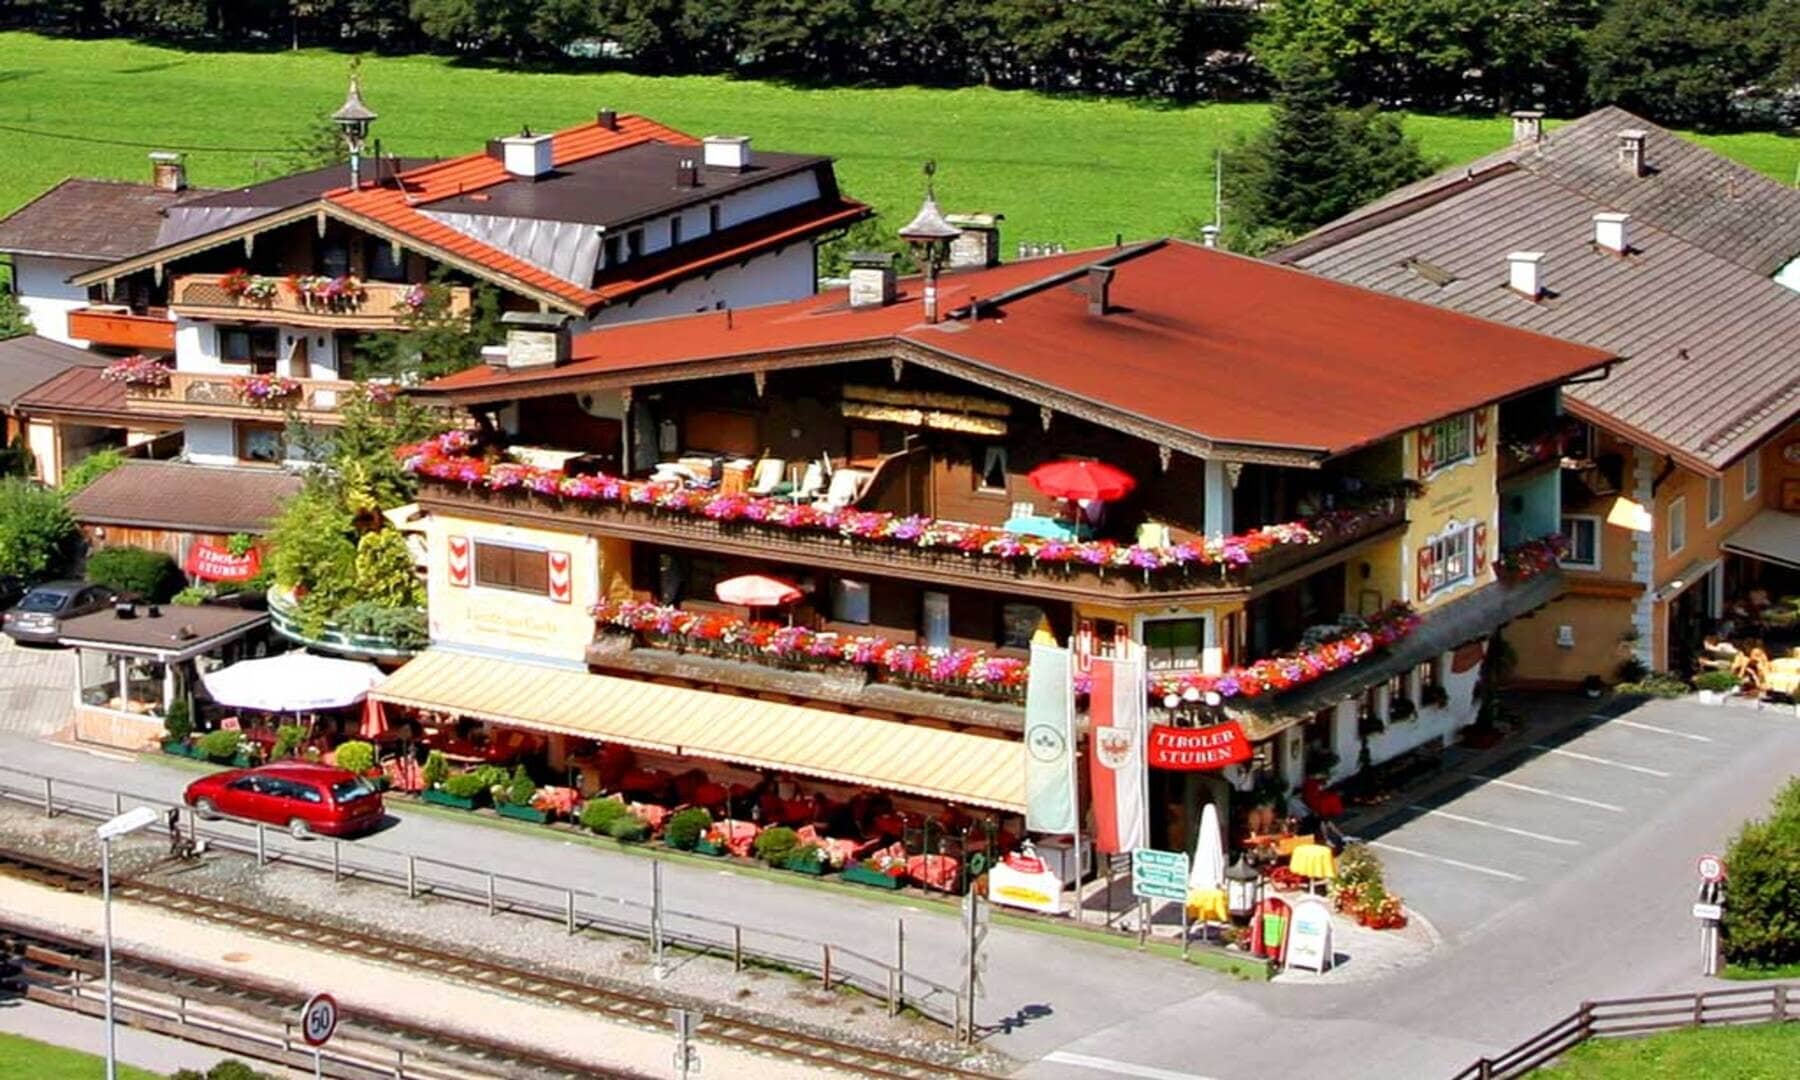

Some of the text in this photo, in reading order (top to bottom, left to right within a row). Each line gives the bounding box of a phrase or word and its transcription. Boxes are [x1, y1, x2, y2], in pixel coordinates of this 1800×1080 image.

[199, 562, 249, 577] STUBEN
[1157, 730, 1234, 748] TIROLER
[1160, 746, 1231, 764] STUBEN
